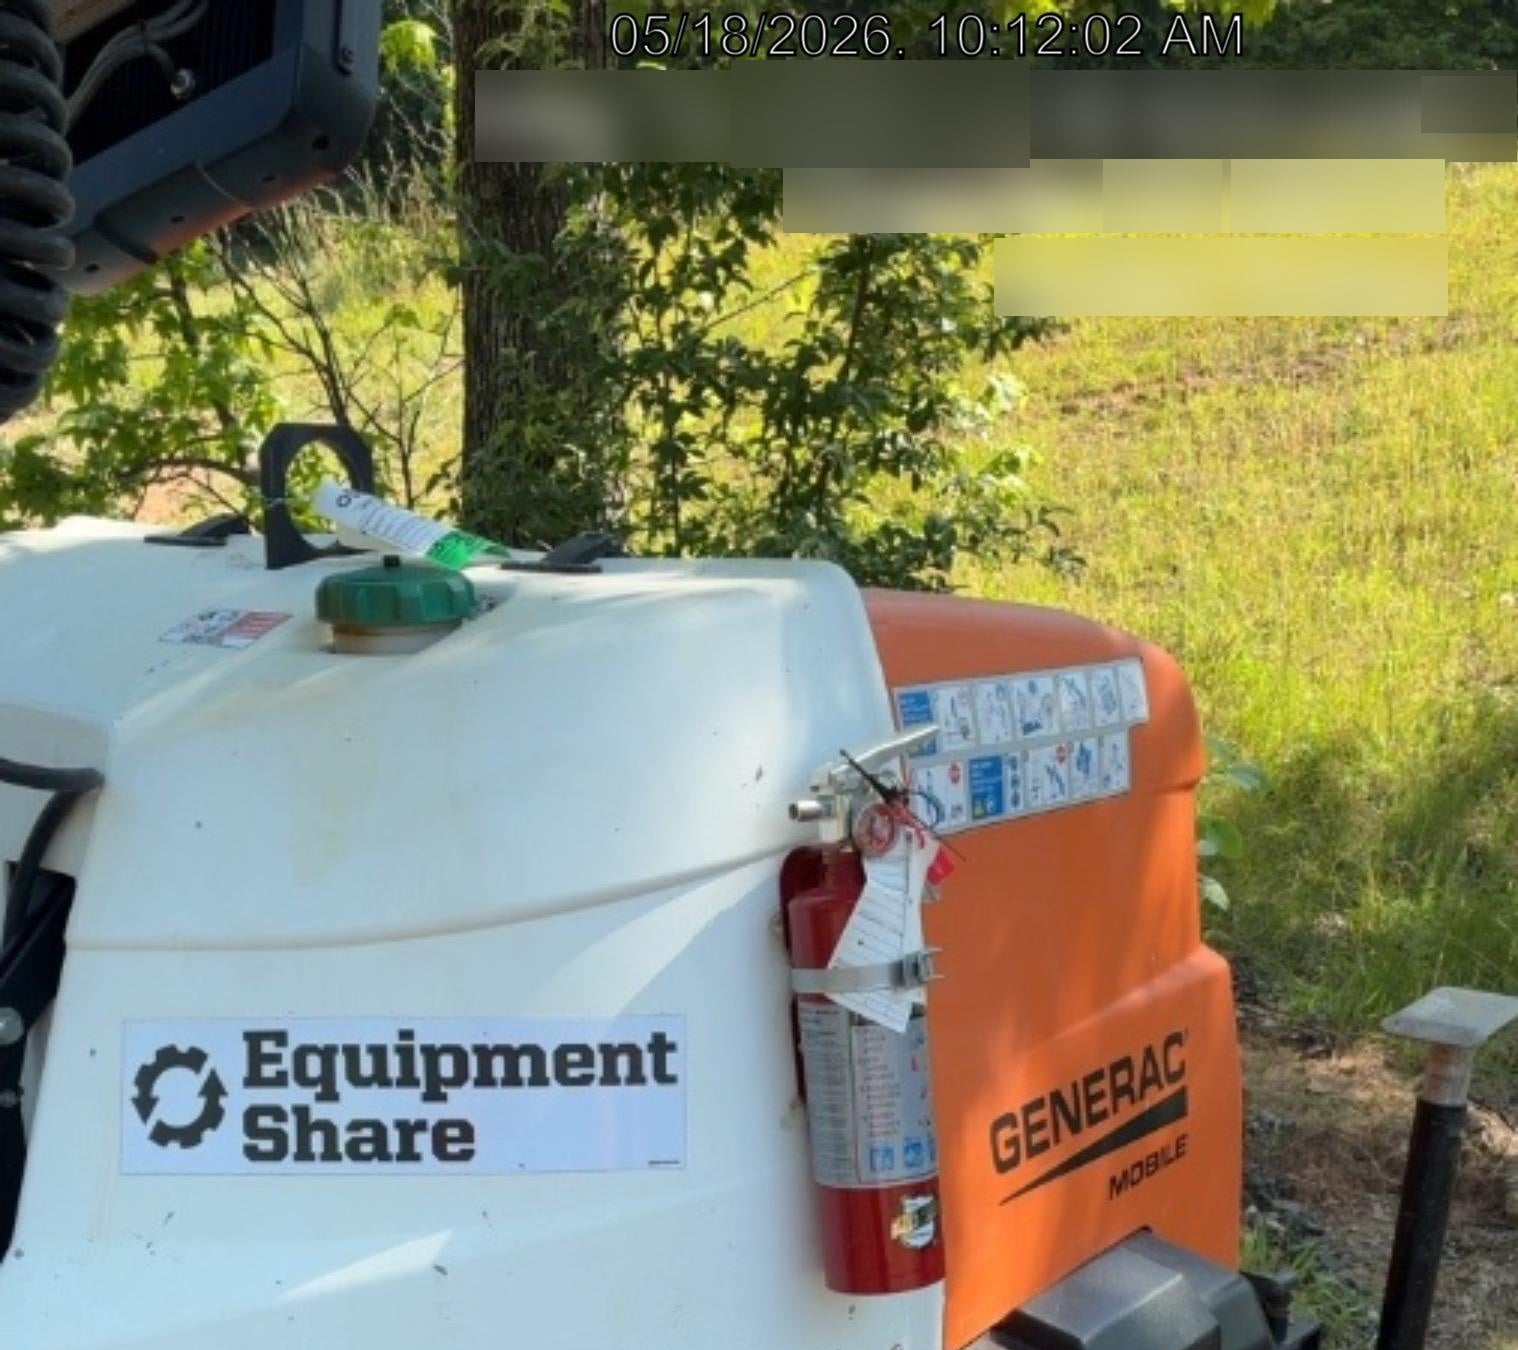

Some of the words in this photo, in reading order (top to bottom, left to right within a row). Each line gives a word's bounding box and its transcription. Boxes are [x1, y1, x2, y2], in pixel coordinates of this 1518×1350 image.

[242, 1029, 679, 1104] Equipment
[989, 1030, 1186, 1175] GENERAC
[242, 1104, 476, 1163] Share
[1108, 1132, 1189, 1201] MOBILE
